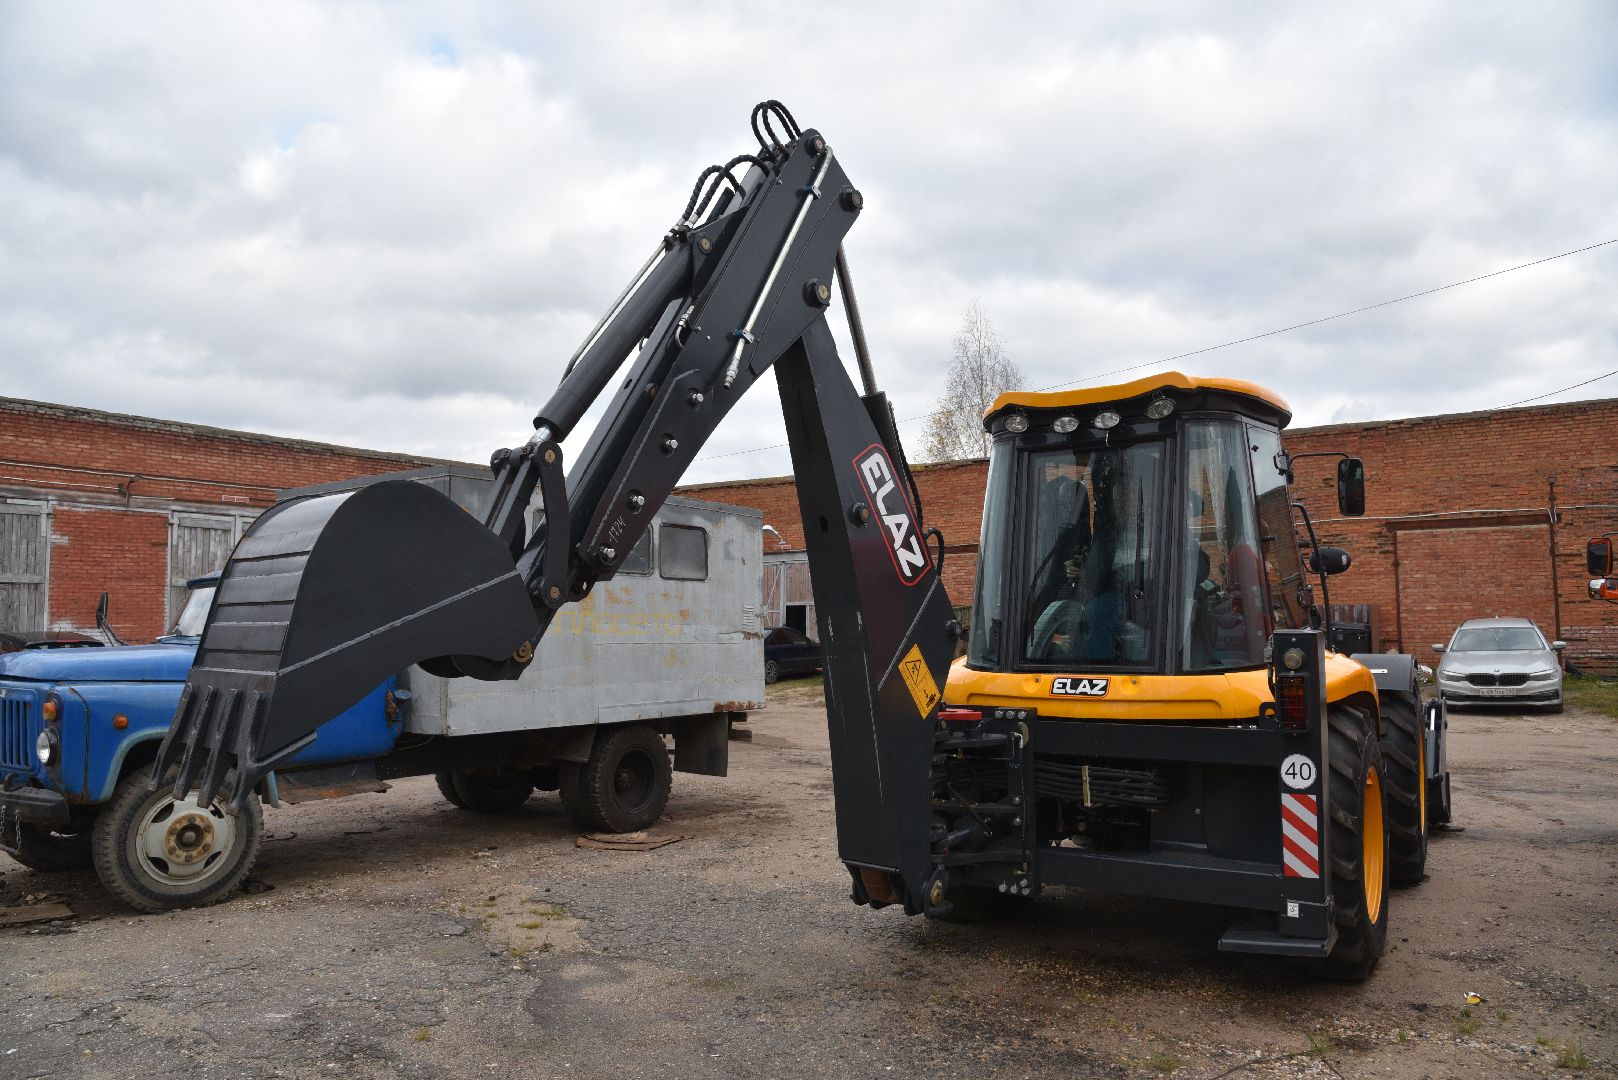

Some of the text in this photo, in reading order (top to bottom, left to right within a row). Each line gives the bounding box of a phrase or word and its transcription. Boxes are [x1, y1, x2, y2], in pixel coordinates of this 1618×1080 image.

[861, 452, 925, 577] ELAZ
[1052, 678, 1107, 695] ELAZ
[1284, 761, 1312, 781] 40
